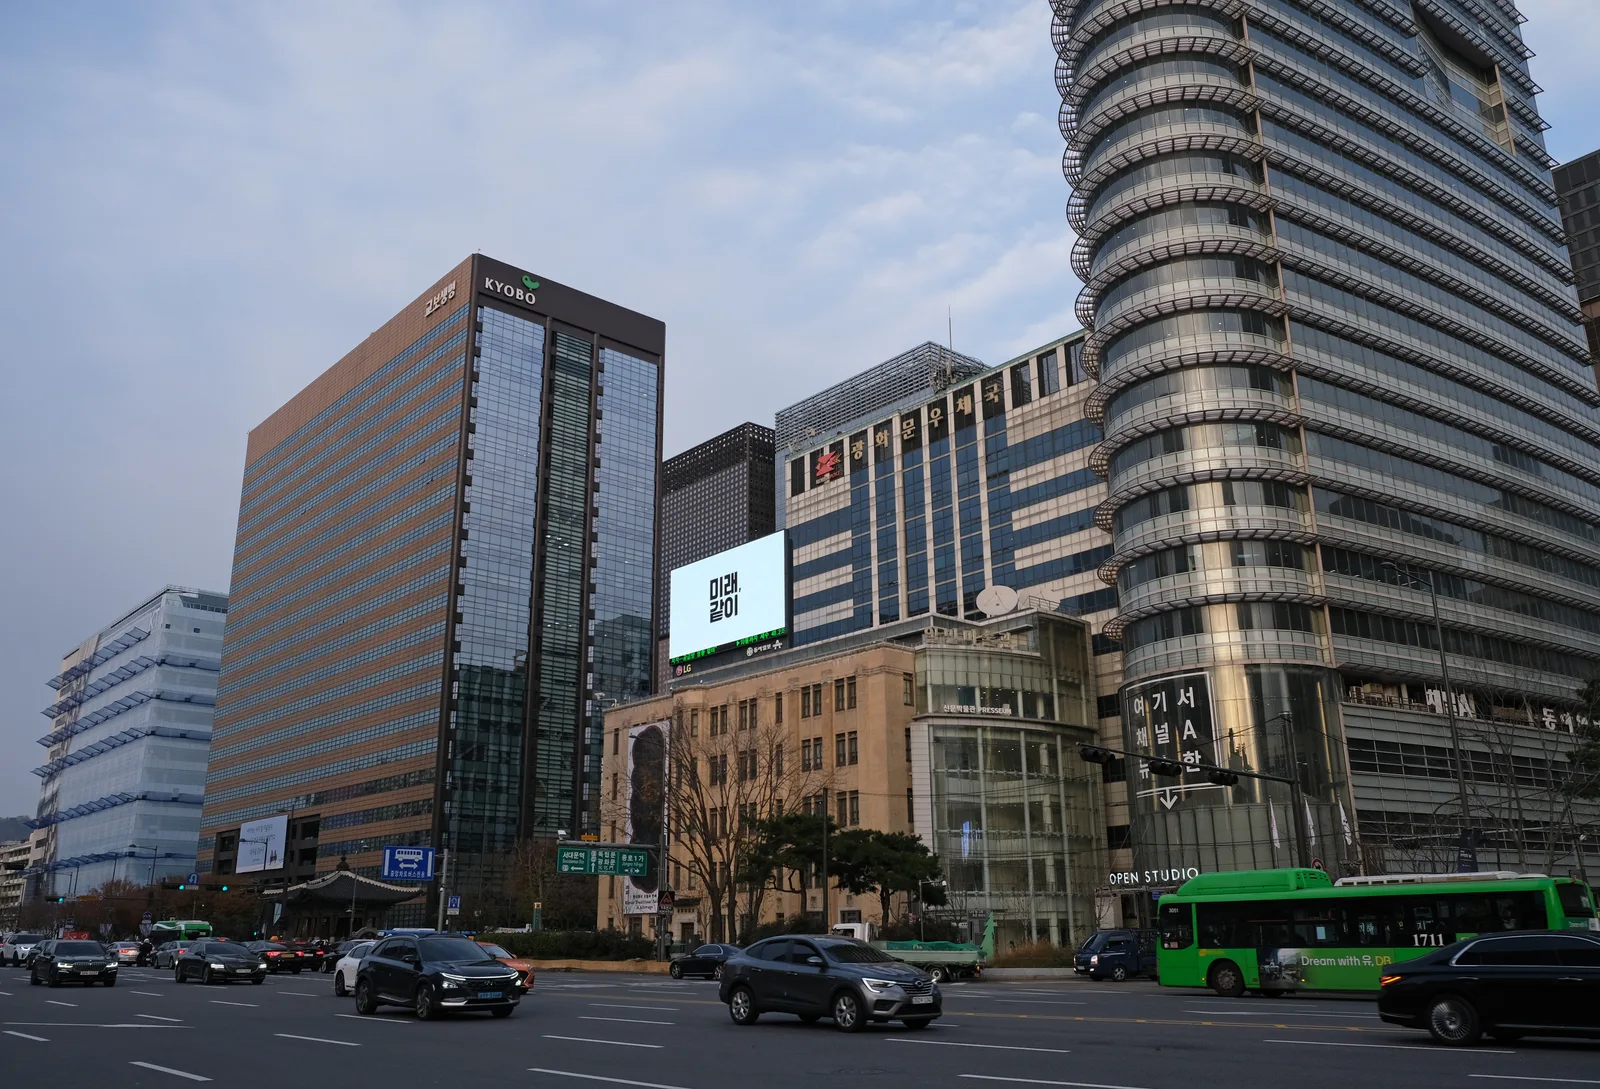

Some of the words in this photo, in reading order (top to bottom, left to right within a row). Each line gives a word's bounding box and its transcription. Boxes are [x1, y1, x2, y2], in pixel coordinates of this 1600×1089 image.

[425, 280, 456, 318] 교보생명
[485, 277, 536, 305] KYOBO
[850, 382, 1000, 460] 광화문우체국
[709, 571, 741, 601] 미래,
[709, 594, 738, 623] 같이
[683, 664, 692, 673] LG
[979, 706, 1012, 715] PRESSEUM
[1133, 686, 1195, 717] 여기서
[1136, 719, 1198, 748] 채널A
[562, 851, 585, 860] 서대문역
[597, 858, 616, 866] 광화문
[1109, 871, 1139, 885] OPEN
[1144, 867, 1199, 883] STUDIO
[1412, 933, 1445, 947] 1711
[1301, 955, 1336, 966] Dream
[1337, 955, 1361, 966] with
